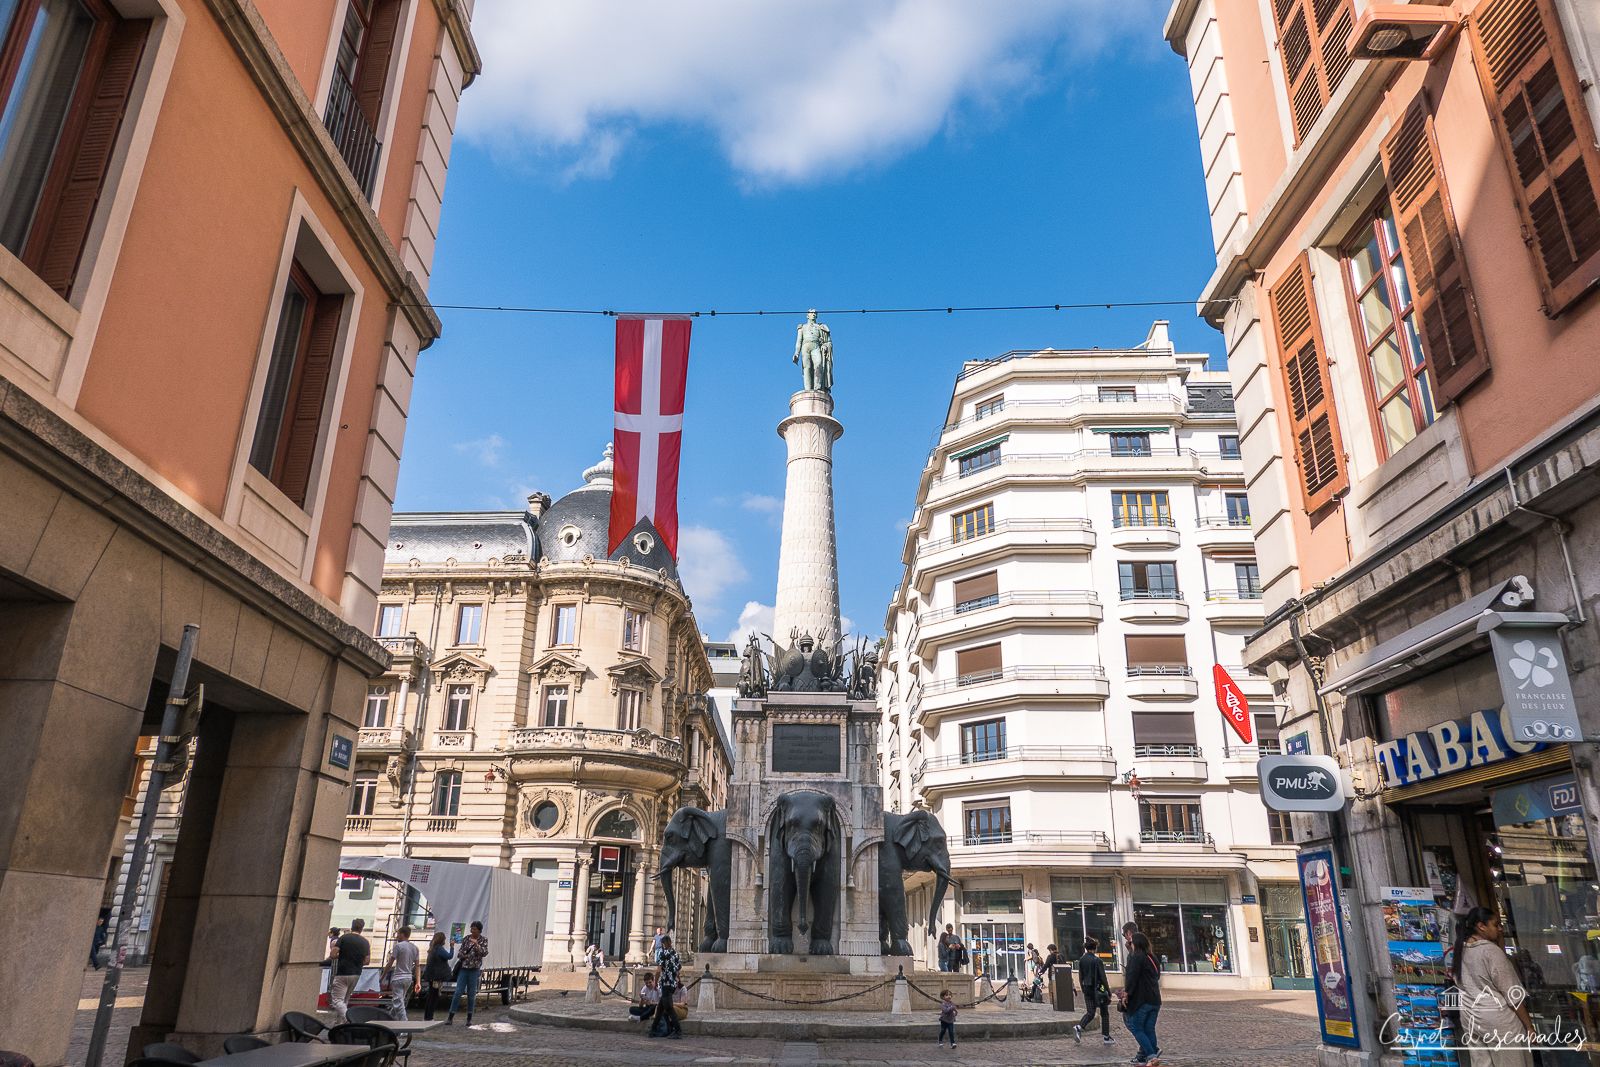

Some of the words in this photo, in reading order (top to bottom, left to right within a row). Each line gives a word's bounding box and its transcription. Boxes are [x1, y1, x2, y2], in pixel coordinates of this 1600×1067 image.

[1222, 684, 1244, 721] TABAC
[1275, 777, 1307, 790] PMU
[1553, 787, 1575, 805] FDJ
